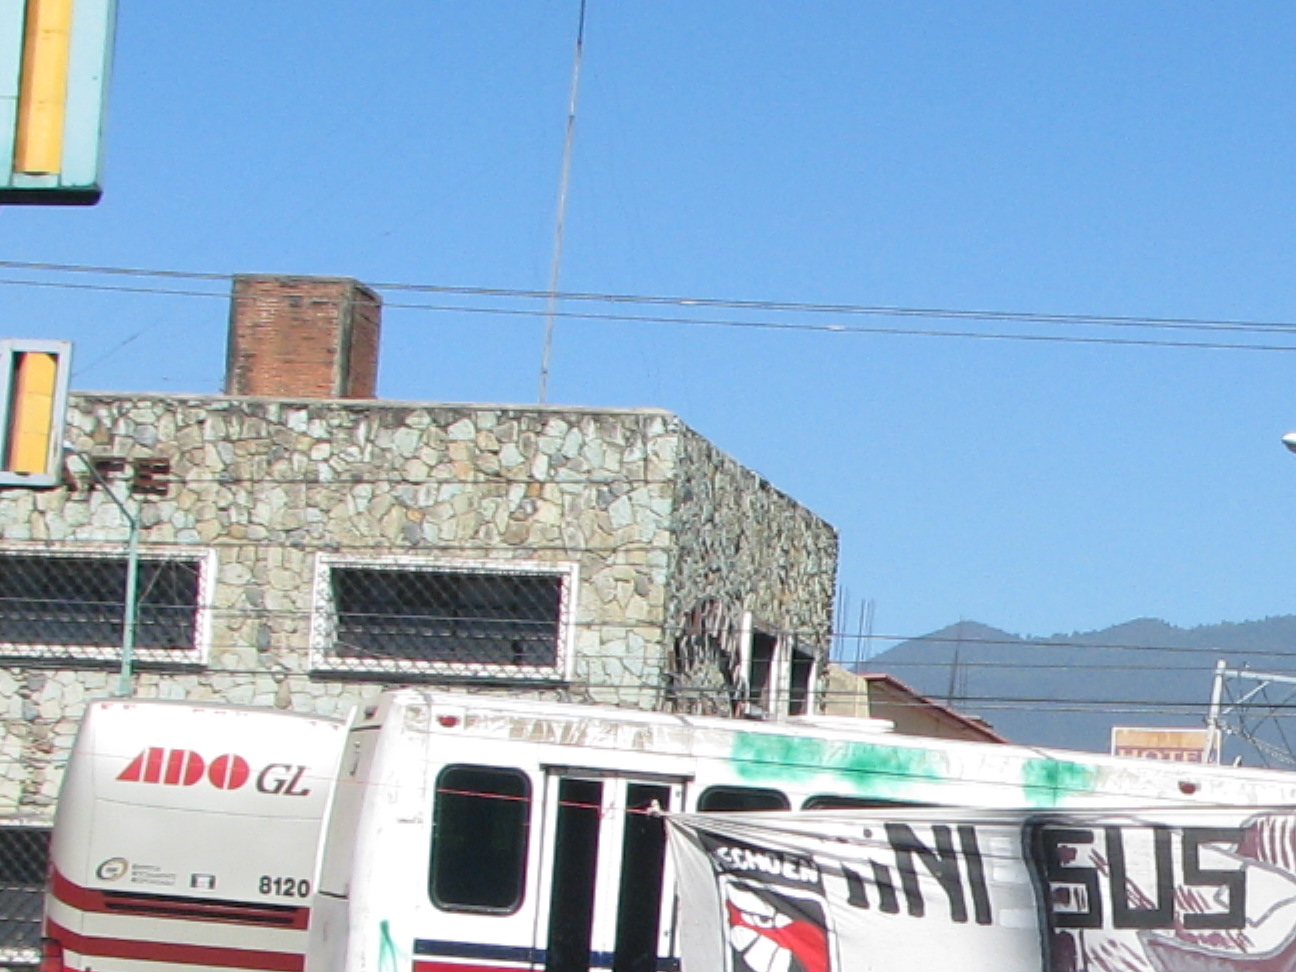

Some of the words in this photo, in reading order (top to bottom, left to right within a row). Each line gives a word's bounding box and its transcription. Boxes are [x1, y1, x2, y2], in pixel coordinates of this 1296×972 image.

[115, 746, 250, 790] ADO
[256, 762, 312, 797] GL
[258, 875, 311, 898] 8120
[1051, 826, 1248, 930] SUS
